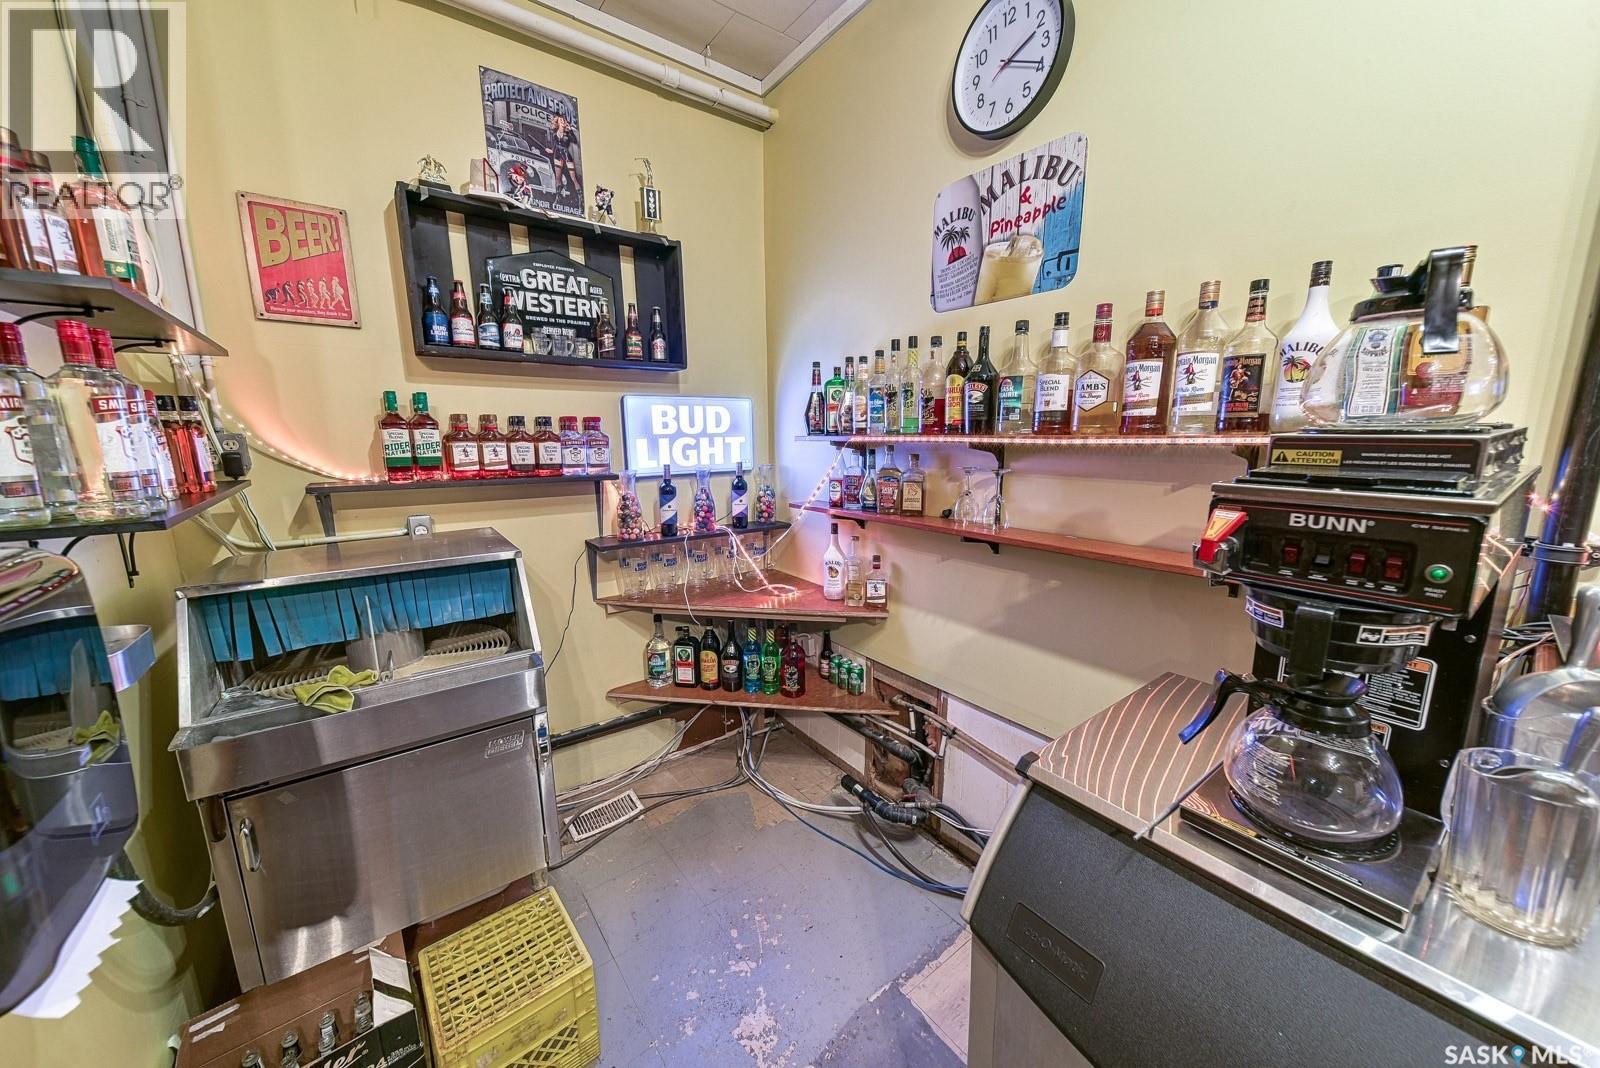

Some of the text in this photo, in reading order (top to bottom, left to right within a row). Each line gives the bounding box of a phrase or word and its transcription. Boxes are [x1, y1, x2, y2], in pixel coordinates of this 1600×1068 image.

[1003, 6, 1016, 28] 12
[1025, 2, 1030, 18] 1
[1037, 9, 1045, 29] 2
[988, 25, 998, 44] 11
[1041, 30, 1050, 48] 3
[975, 49, 988, 68] 10
[1036, 56, 1044, 72] 4
[973, 75, 980, 91] 9
[1022, 80, 1031, 98] 5
[484, 82, 577, 127] PROTECT AND SERVE
[977, 93, 984, 109] 8
[989, 101, 996, 118] 7
[1005, 97, 1013, 114] 6
[515, 104, 552, 121] POLICE
[511, 155, 535, 165] POLICE
[981, 155, 1081, 216] MALIBU
[1020, 185, 1032, 204] &
[552, 202, 583, 216] COURAGE
[990, 195, 1067, 239] Pineapple
[934, 206, 976, 239] MALIBU
[254, 206, 340, 268] BEER!
[520, 268, 589, 296] GREAT
[512, 289, 600, 319] WESTERN
[1139, 363, 1160, 373] Morgan
[1193, 355, 1217, 366] Morgan
[650, 404, 731, 435] BUD
[384, 441, 410, 452] RIDER
[416, 441, 441, 451] RIDER
[635, 436, 746, 469] LIGHT
